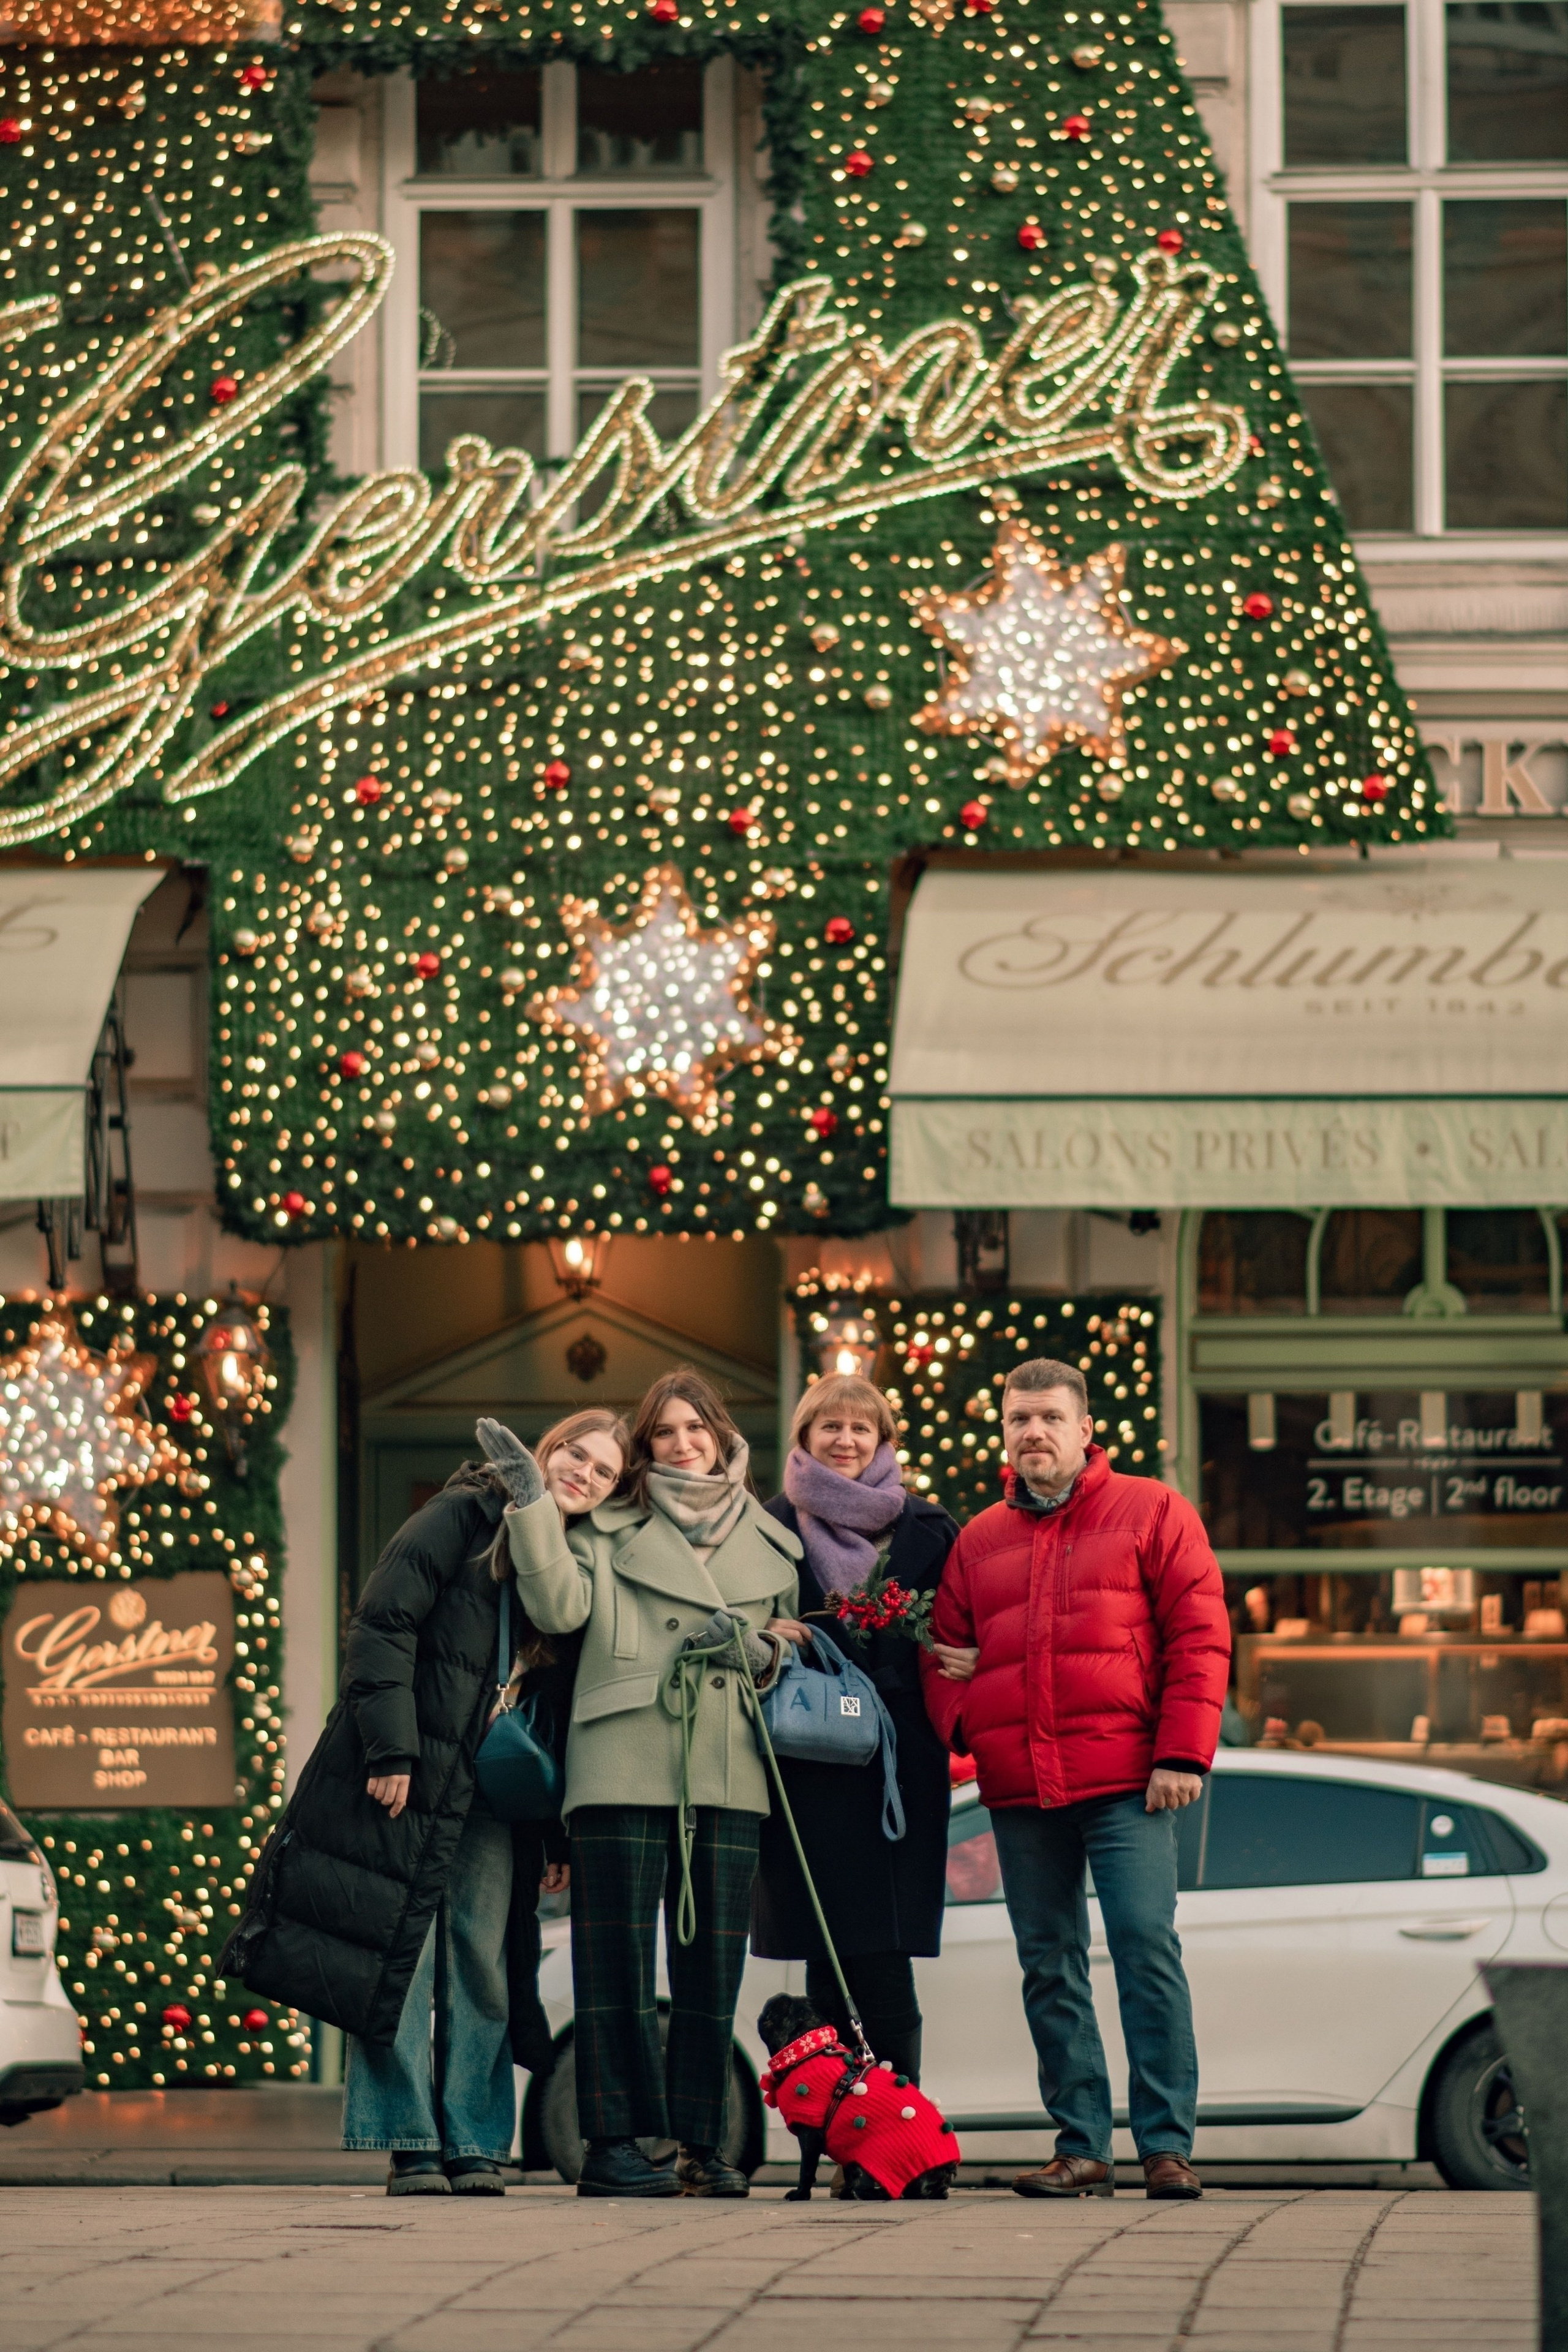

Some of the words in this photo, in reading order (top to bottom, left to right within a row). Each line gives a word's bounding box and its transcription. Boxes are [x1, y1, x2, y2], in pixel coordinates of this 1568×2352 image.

[966, 1128, 1172, 1171] SALONS
[1193, 1116, 1381, 1171] PRIVÉS
[1470, 1127, 1568, 1170] SAL
[1307, 1477, 1336, 1509] 2.
[1343, 1477, 1425, 1518] Etage
[1446, 1476, 1487, 1507] 2nd
[1494, 1476, 1562, 1507] floor
[91, 1727, 217, 1747] RESTAURANT
[99, 1748, 140, 1768] BAR
[93, 1770, 148, 1790] SHOP
